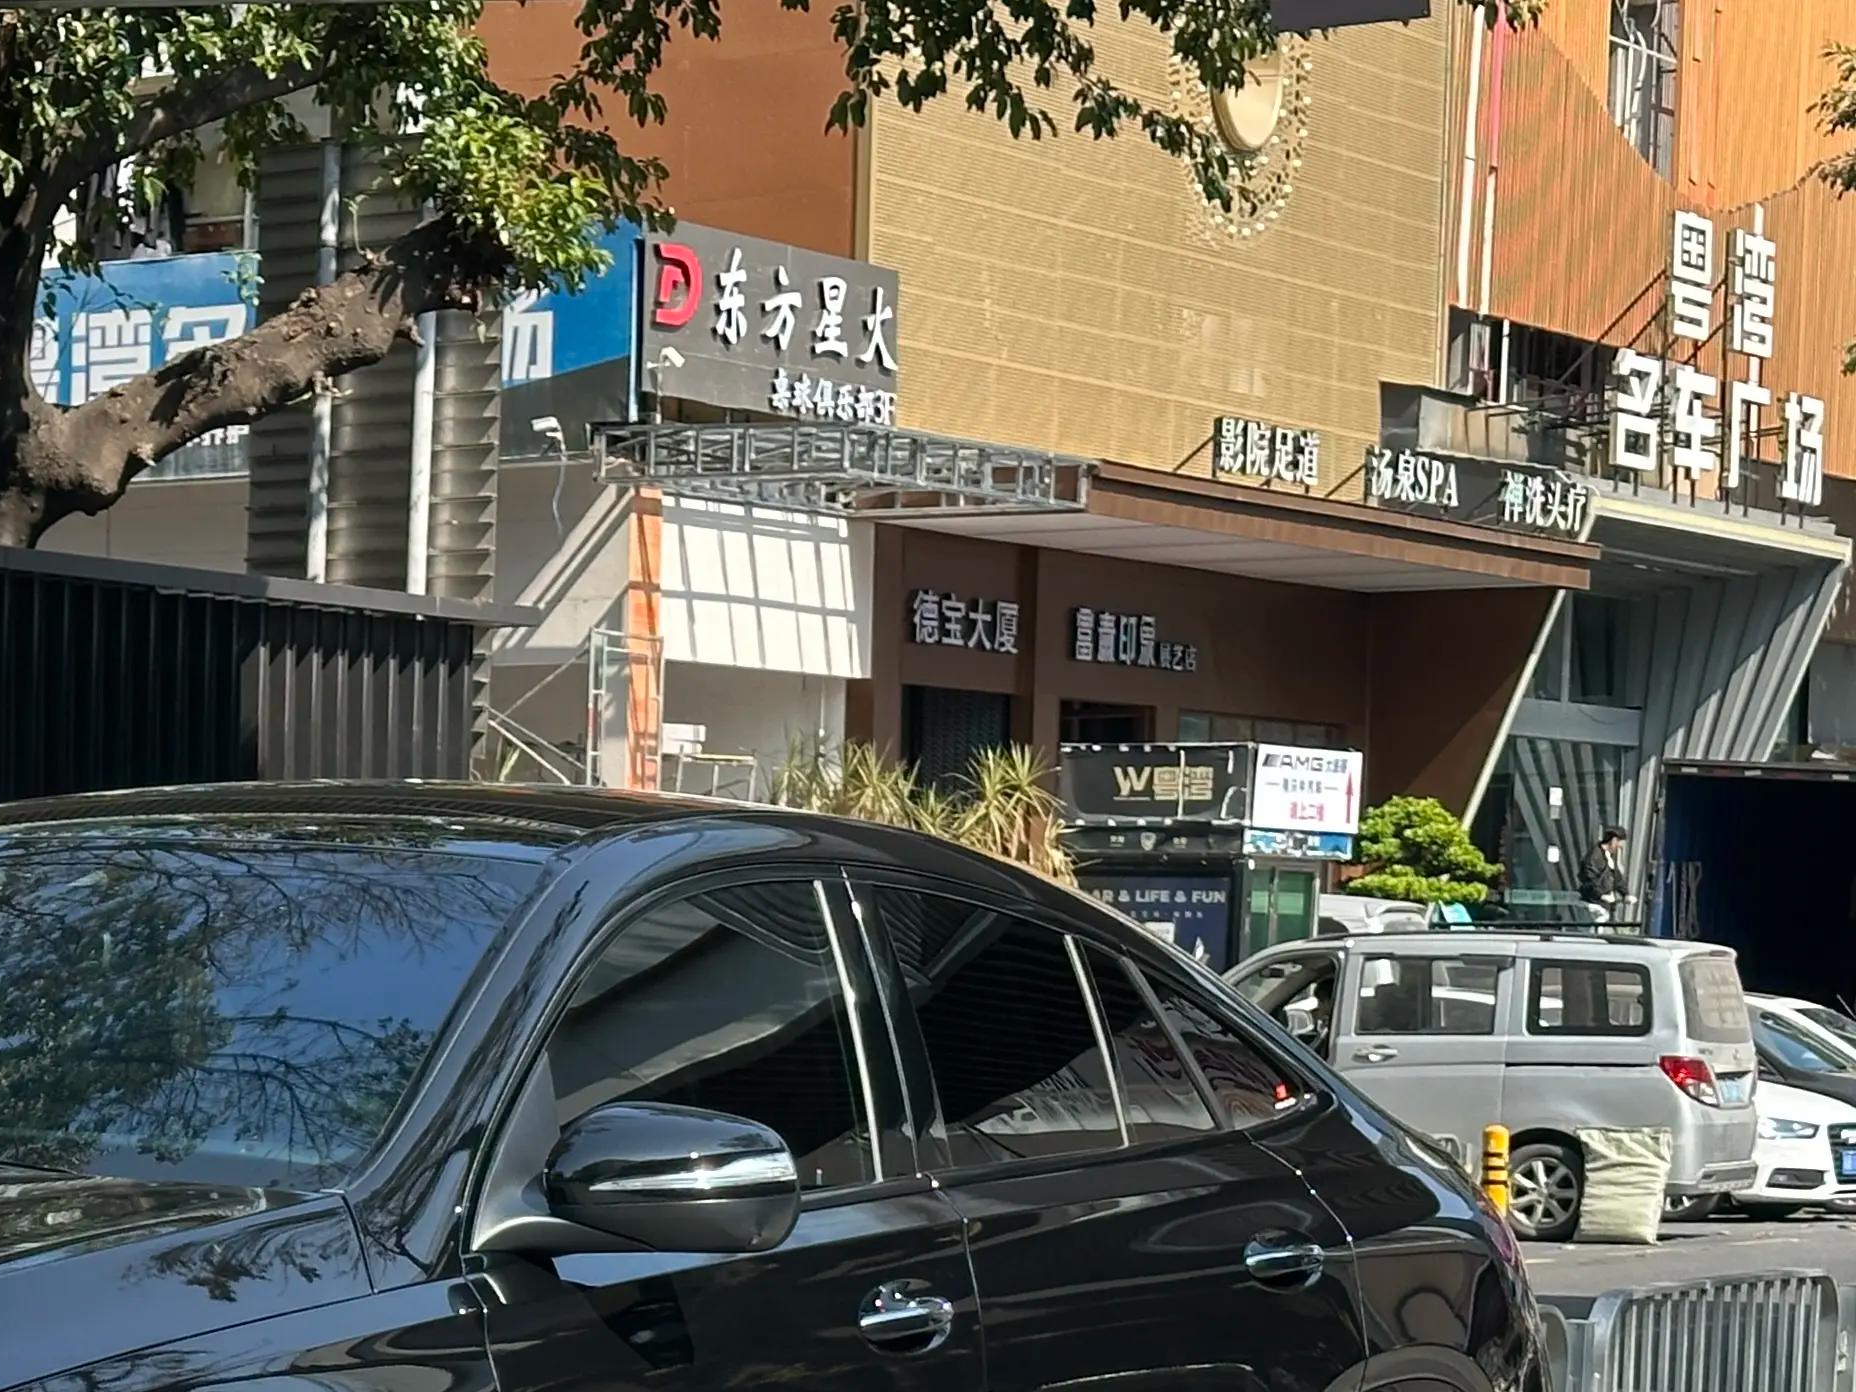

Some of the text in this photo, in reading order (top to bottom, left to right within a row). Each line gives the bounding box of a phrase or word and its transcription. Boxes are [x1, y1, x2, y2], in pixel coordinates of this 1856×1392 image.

[715, 247, 898, 371] 东方星火
[1219, 416, 1320, 486] 影院足道
[1615, 347, 1825, 507] 名车广场
[1370, 446, 1459, 507] 汤泉SPA
[912, 589, 1019, 654] 德宝大厦
[1135, 889, 1171, 903] LIFE
[1191, 890, 1227, 904] FUN
